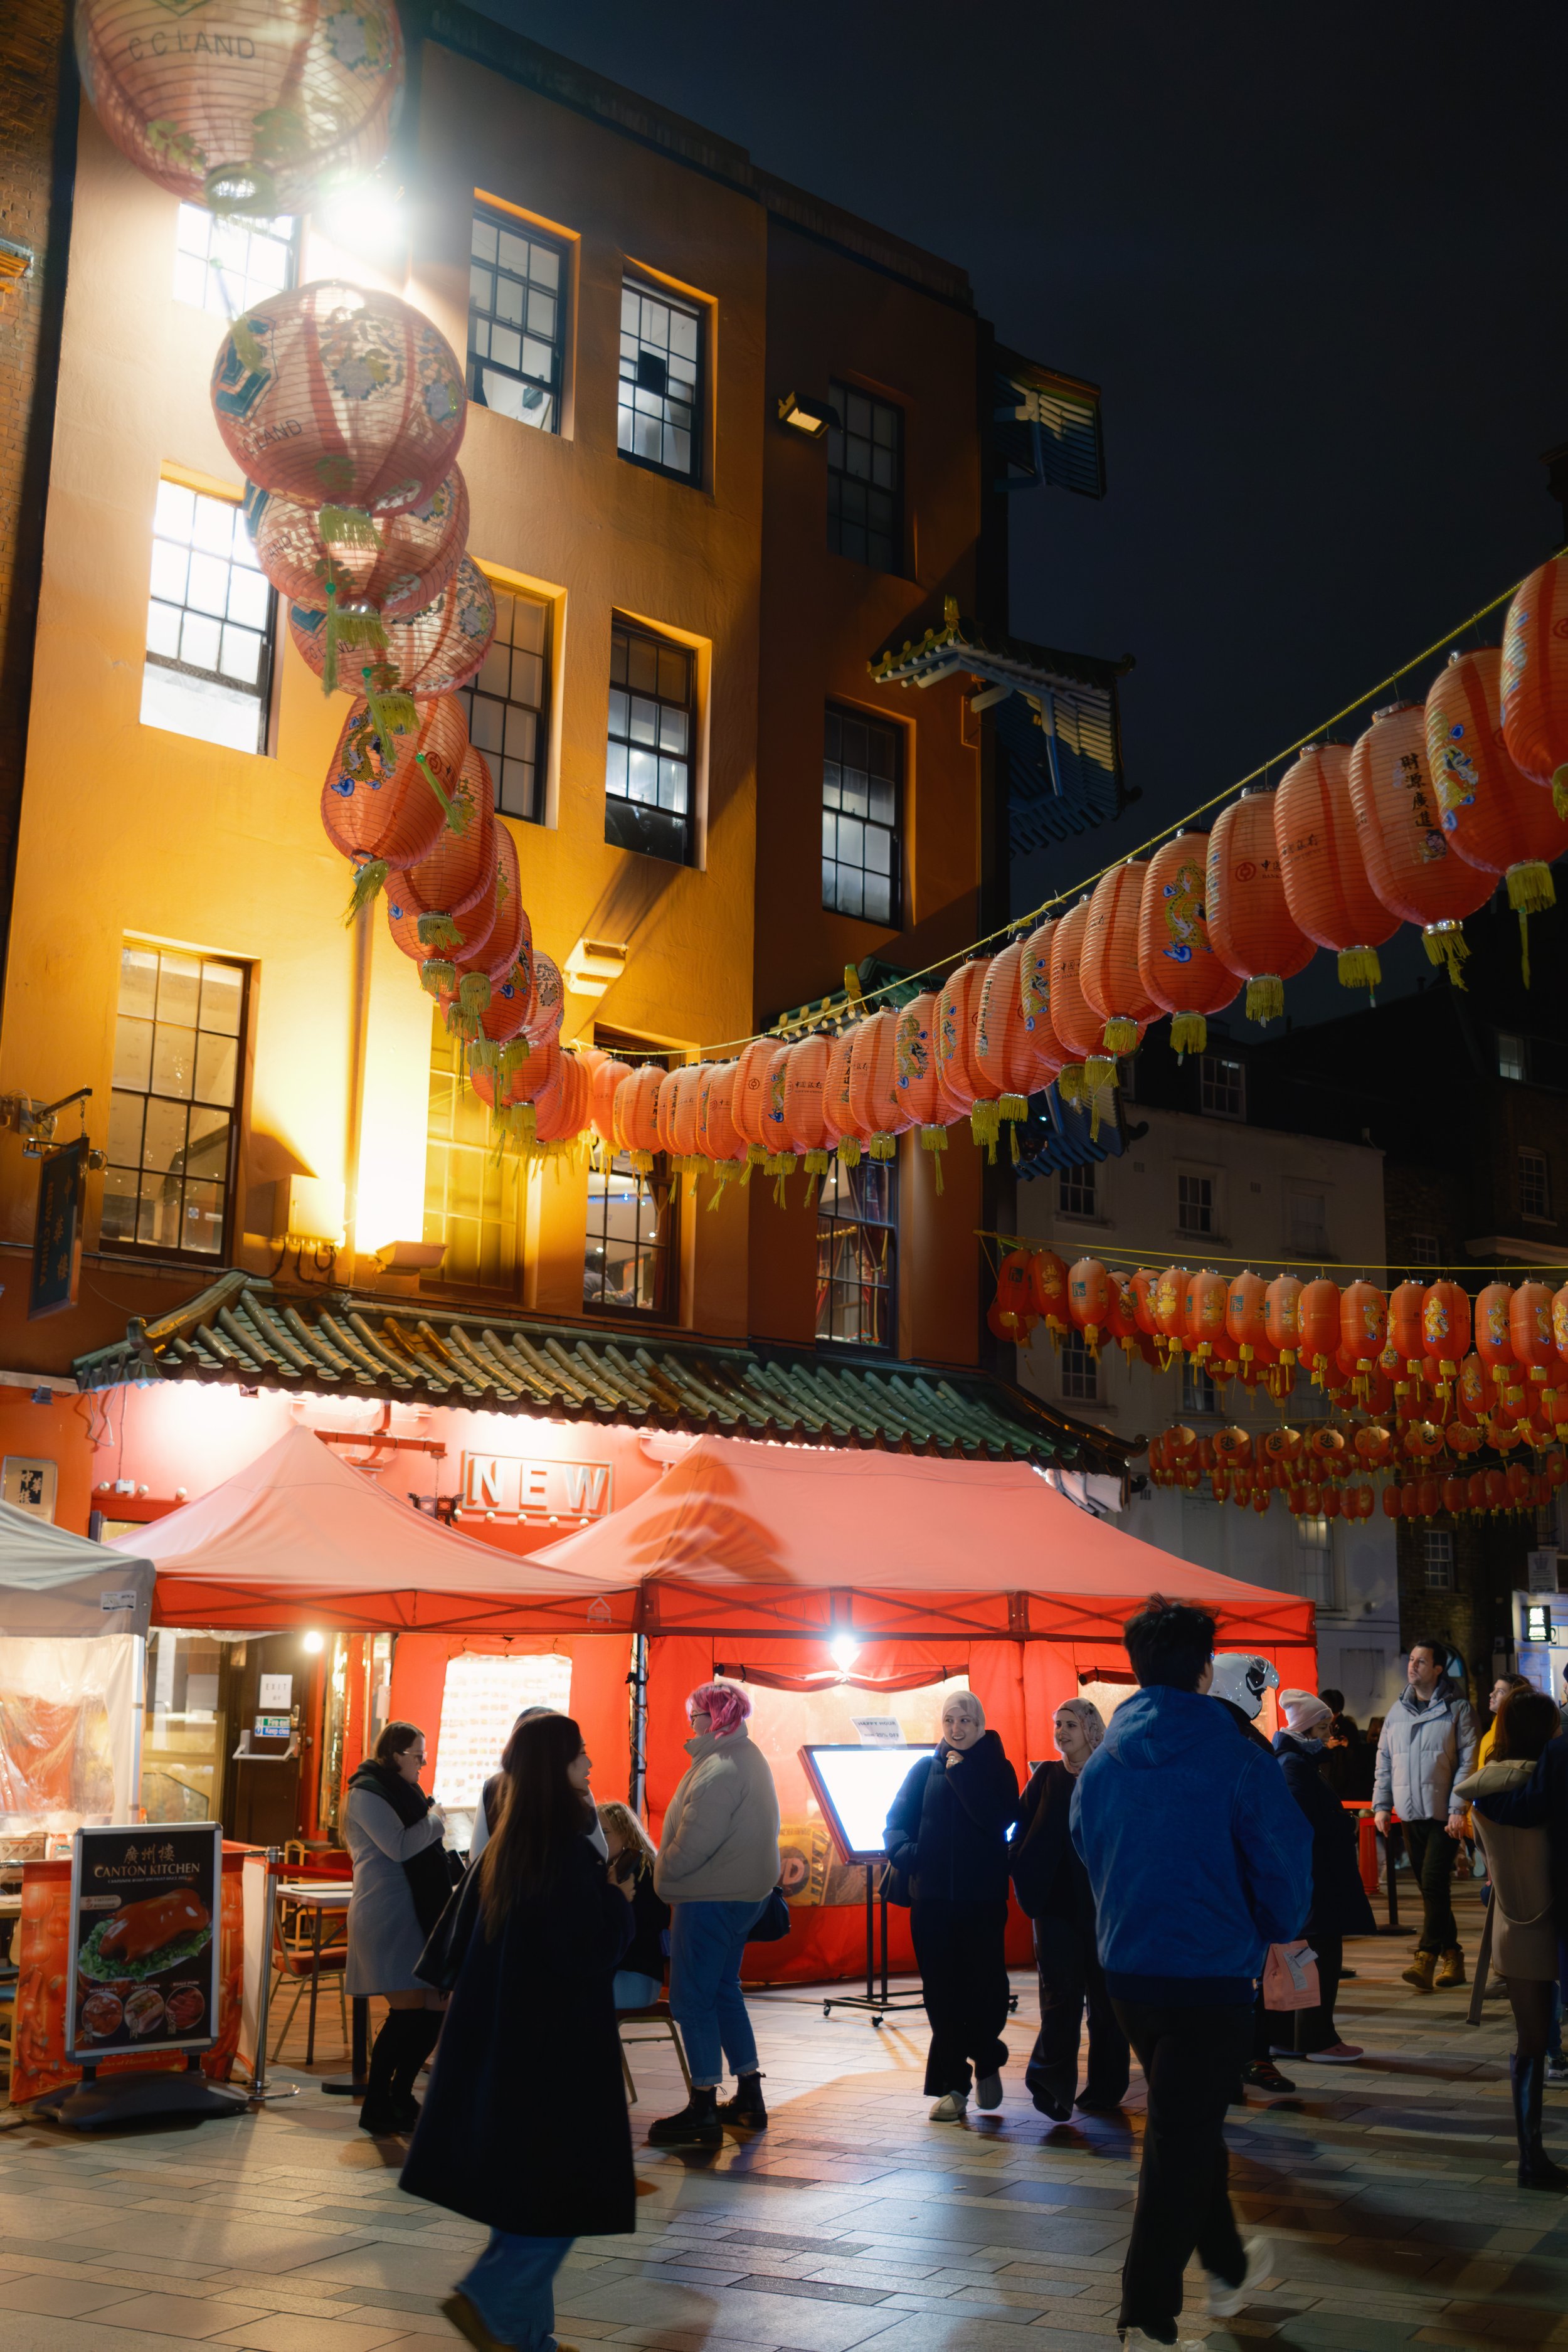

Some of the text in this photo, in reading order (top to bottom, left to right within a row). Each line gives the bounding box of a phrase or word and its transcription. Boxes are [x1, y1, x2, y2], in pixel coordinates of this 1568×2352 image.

[177, 29, 255, 59] LAND
[252, 419, 302, 449] LAND
[1400, 753, 1434, 828] 財源廣進
[471, 1457, 607, 1510] NEW
[124, 1843, 176, 1865] 廣州樓
[94, 1863, 201, 1878] CANTON KITCHEN
